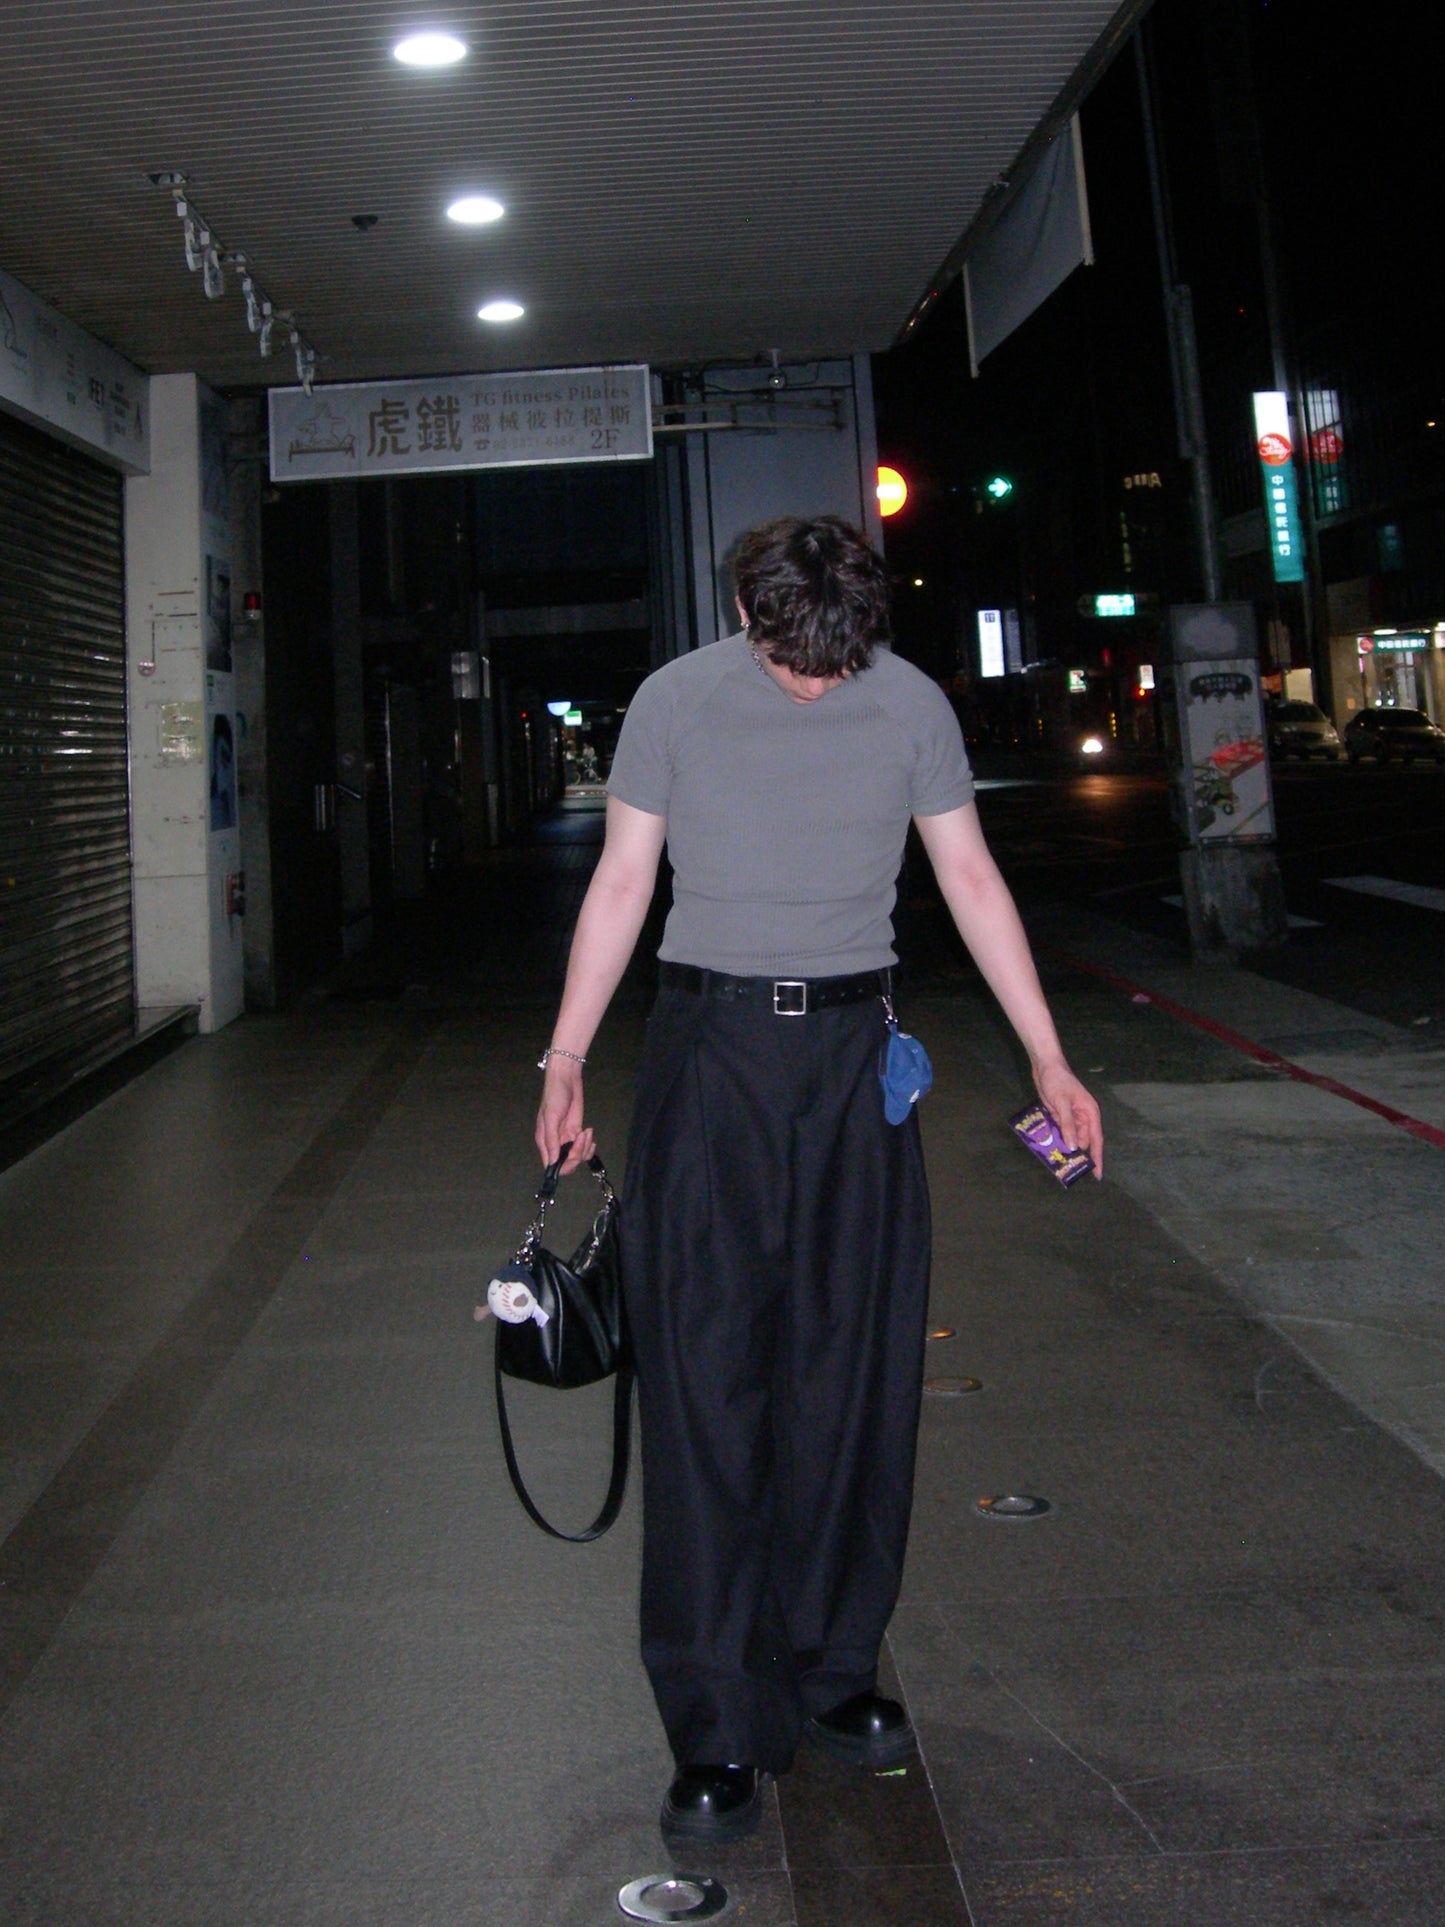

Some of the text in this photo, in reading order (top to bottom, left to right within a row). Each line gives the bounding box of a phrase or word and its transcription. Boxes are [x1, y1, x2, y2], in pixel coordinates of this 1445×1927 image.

[502, 389, 563, 405] fitness
[568, 386, 630, 401] Pilates
[367, 395, 464, 458] 虎鐵
[591, 428, 621, 450] 2F
